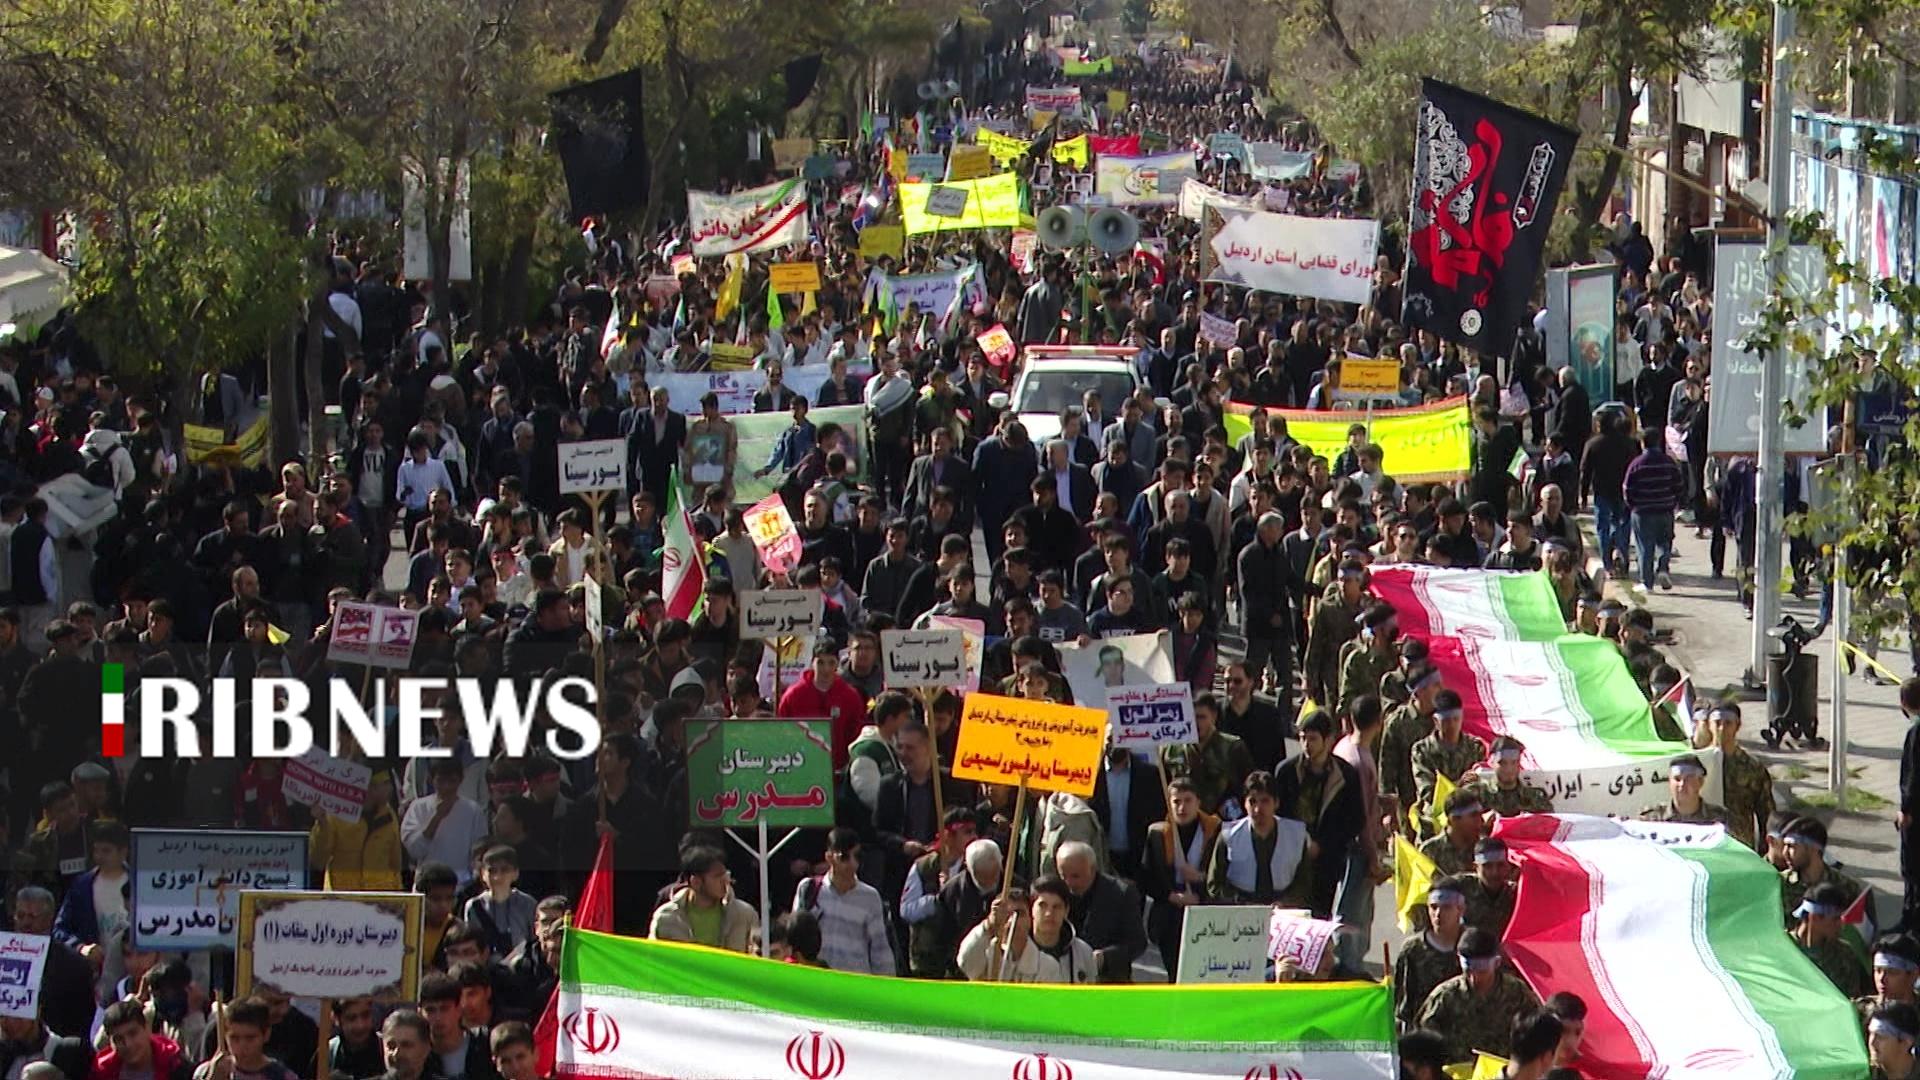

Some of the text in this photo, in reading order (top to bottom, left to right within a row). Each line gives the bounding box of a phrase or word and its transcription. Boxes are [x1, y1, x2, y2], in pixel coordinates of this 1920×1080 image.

[1224, 241, 1262, 261] اردبیل
[1264, 250, 1297, 265] استان
[1299, 254, 1338, 270] قضایی
[564, 462, 621, 486] پورسینا
[746, 610, 814, 632] پورسینا
[889, 651, 961, 680] پورسینا
[718, 748, 804, 775] دبیرستان
[1542, 772, 1583, 800] ایران
[1608, 767, 1644, 796] قوی
[696, 780, 827, 822] مدرس
[138, 907, 216, 937] مدرس
[1191, 918, 1231, 944] اسلامی
[1232, 919, 1265, 943] انجمن
[355, 923, 398, 947] دبیرستان
